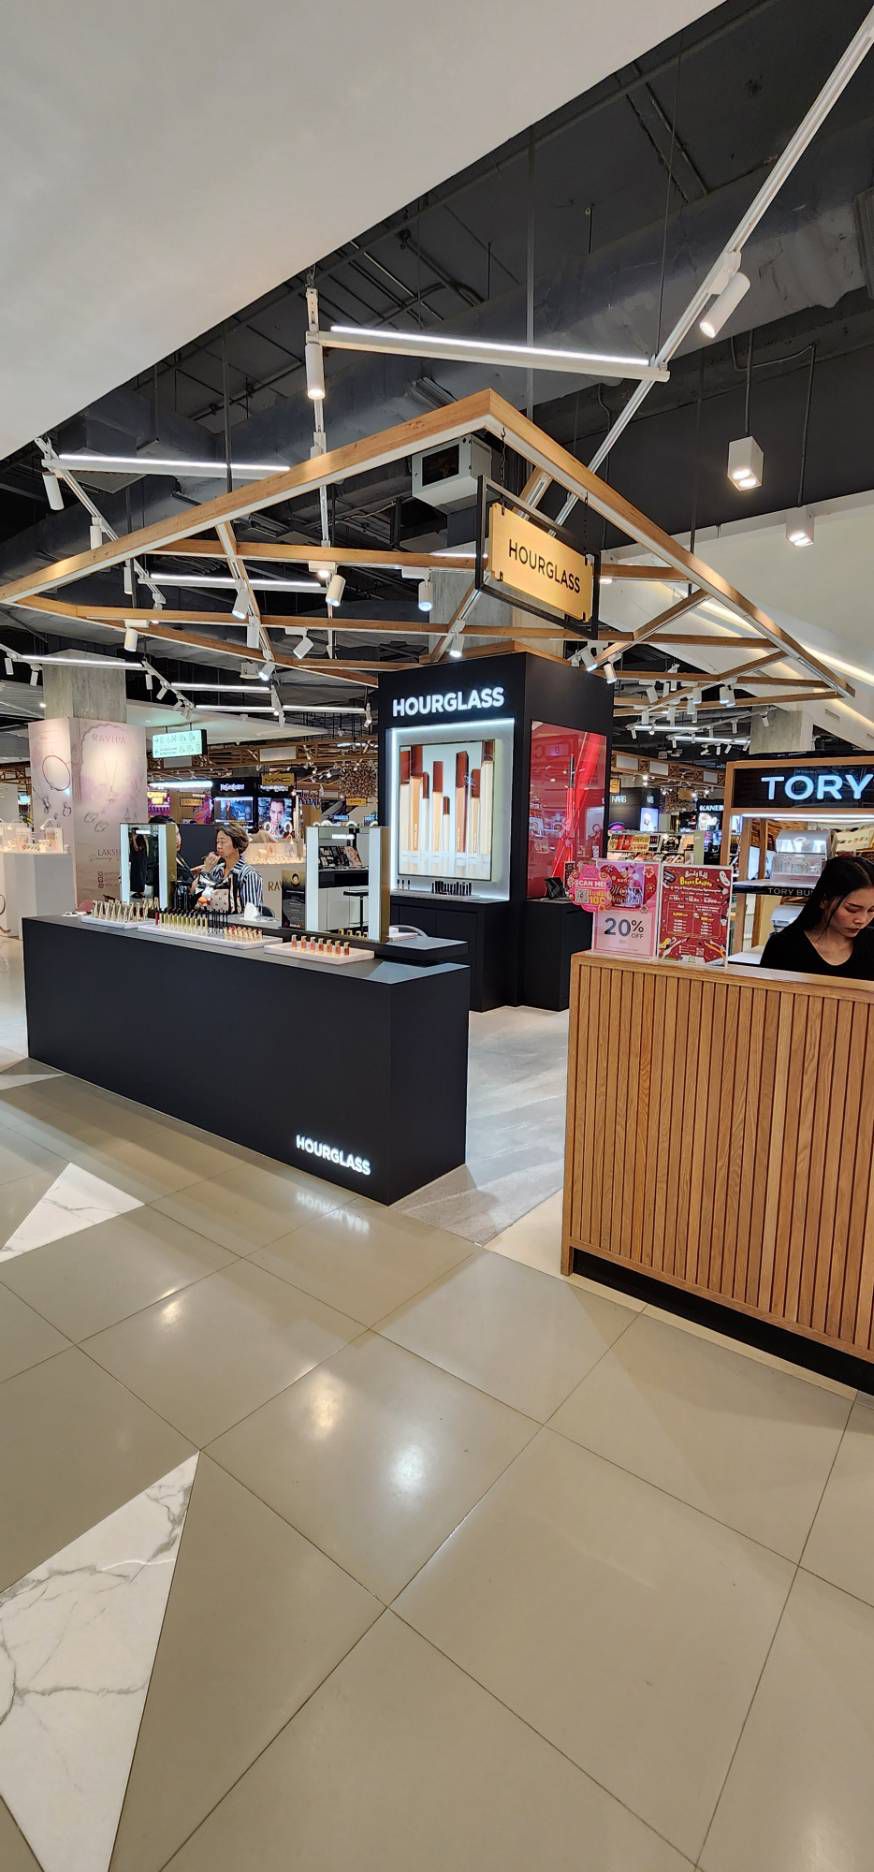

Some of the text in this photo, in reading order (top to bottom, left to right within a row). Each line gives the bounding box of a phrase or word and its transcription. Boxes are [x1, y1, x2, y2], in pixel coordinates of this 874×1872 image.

[508, 538, 581, 594] HOURGLASS
[392, 686, 505, 718] HOURGLASS
[760, 773, 874, 800] TORY
[768, 887, 794, 896] TORY
[604, 917, 644, 937] 20%
[296, 1134, 371, 1175] HOURGLASS
